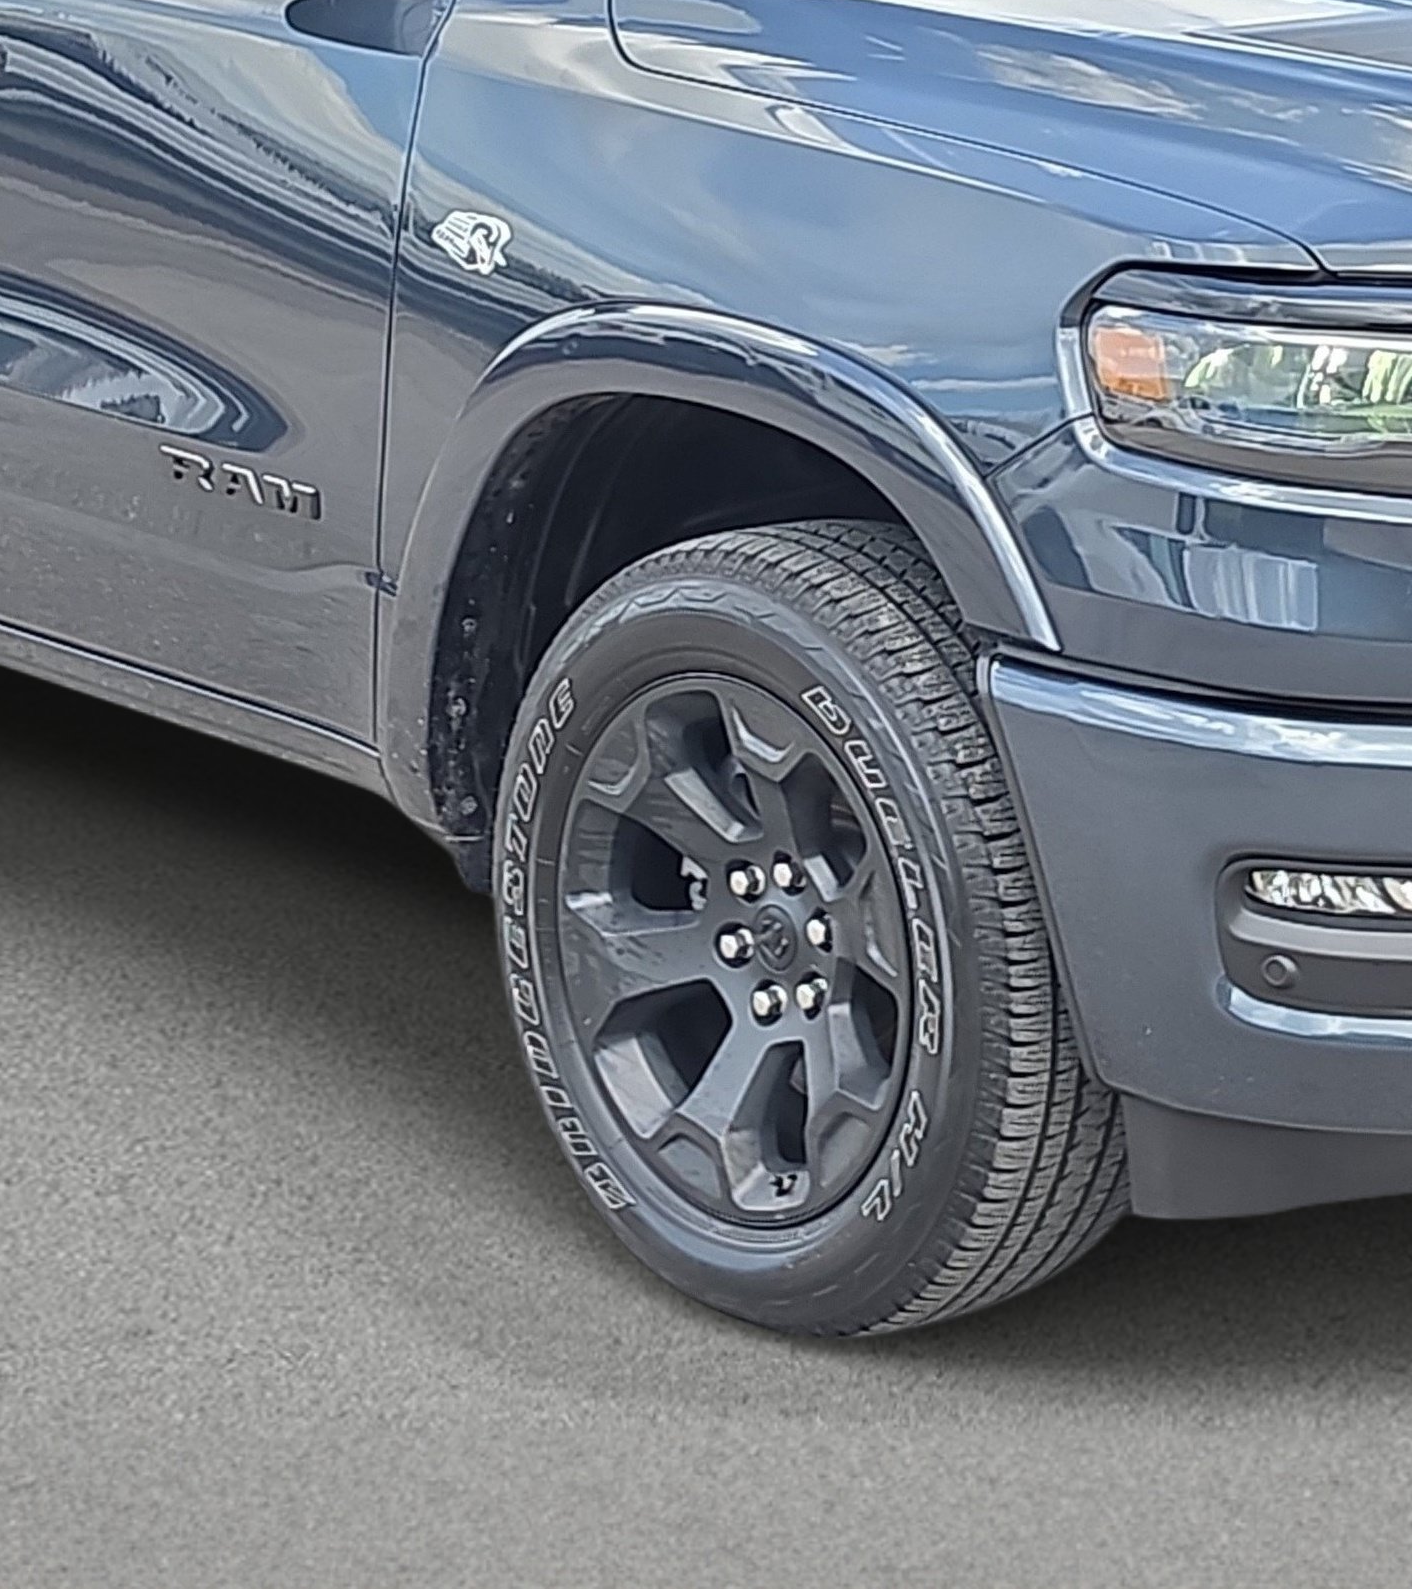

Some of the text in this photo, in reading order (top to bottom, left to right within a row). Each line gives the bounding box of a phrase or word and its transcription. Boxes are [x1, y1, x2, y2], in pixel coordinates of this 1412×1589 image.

[159, 443, 322, 521] RAM
[502, 677, 637, 1210] BRIDGESTONE
[801, 685, 941, 1055] DUELER
